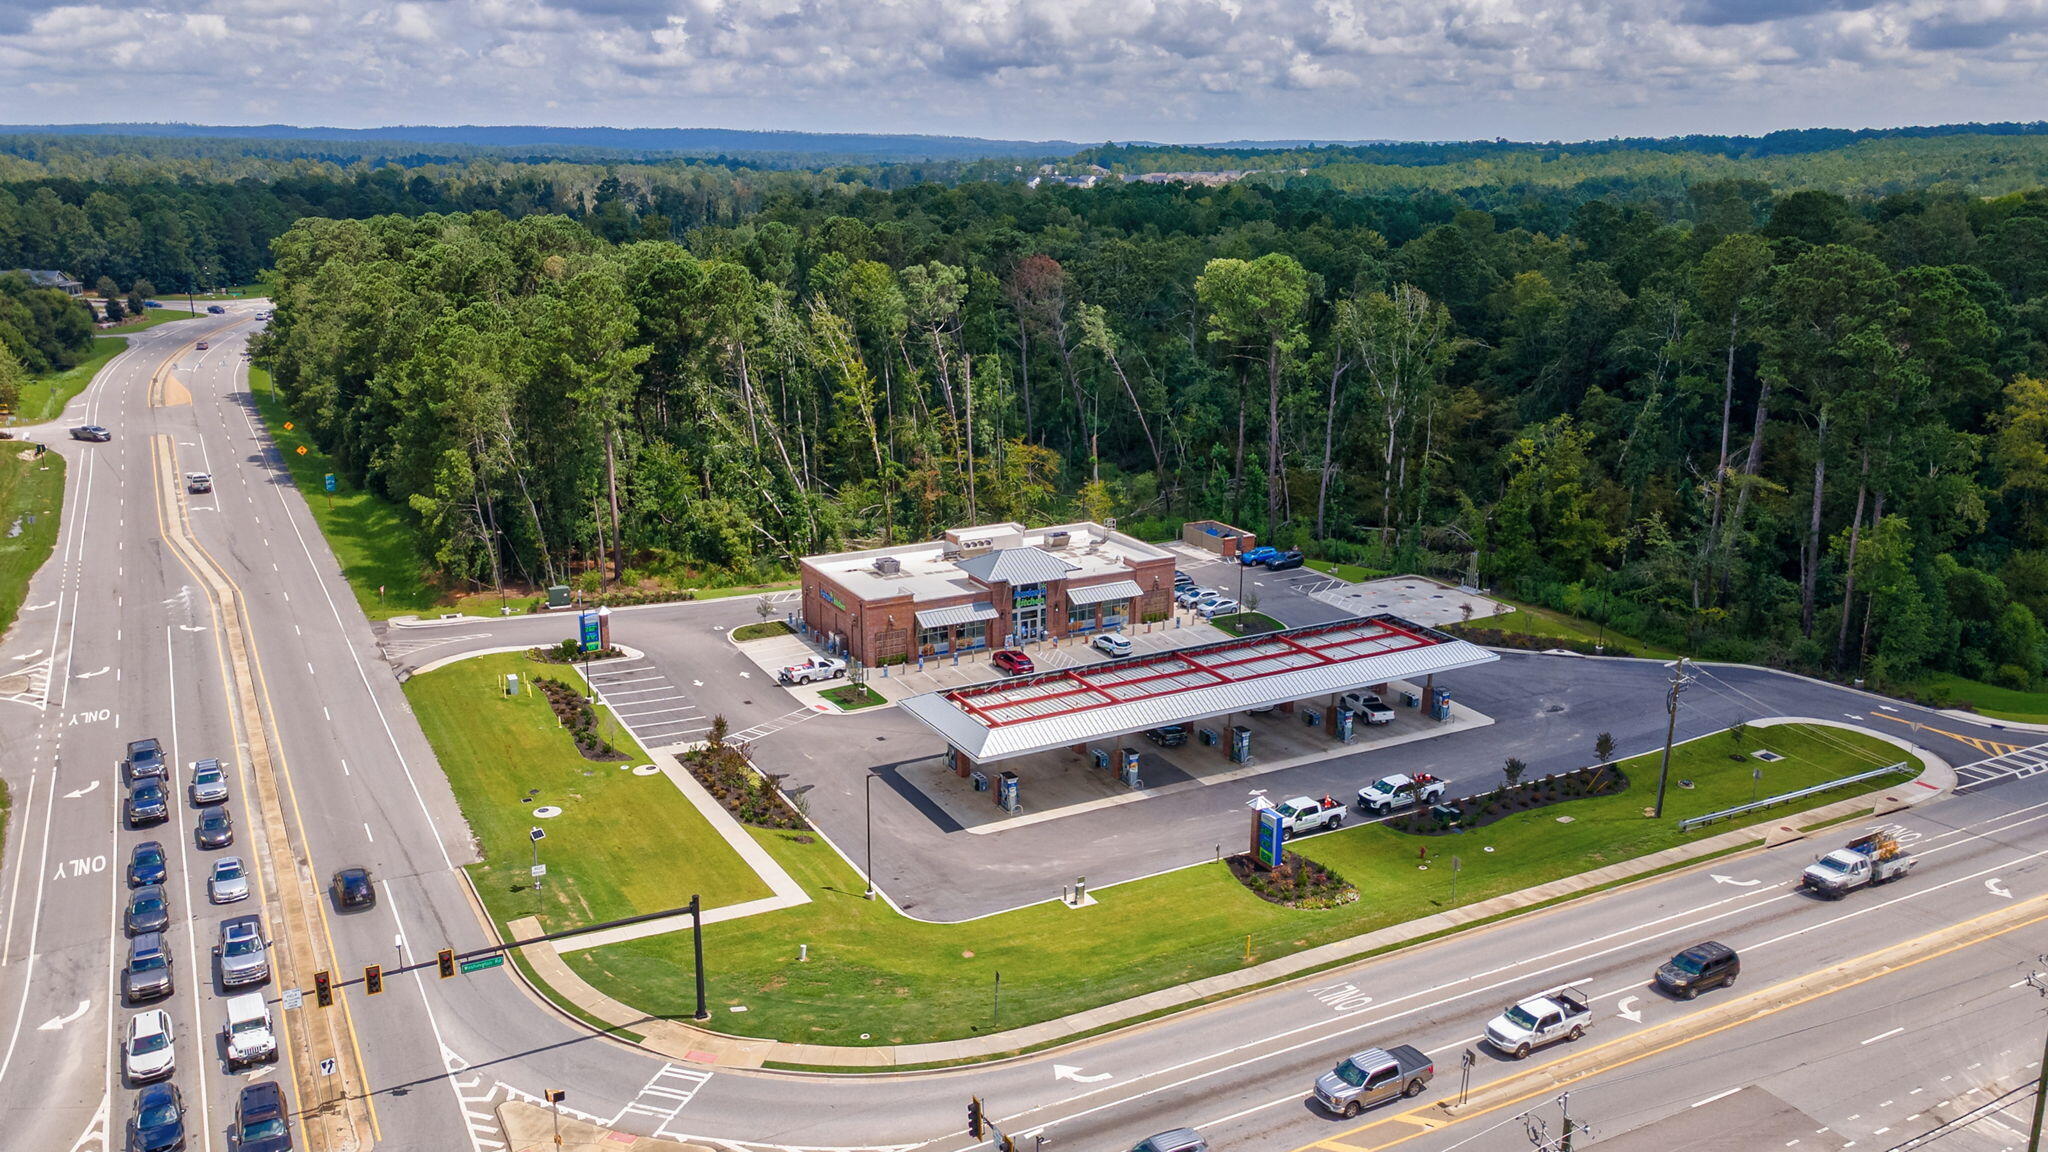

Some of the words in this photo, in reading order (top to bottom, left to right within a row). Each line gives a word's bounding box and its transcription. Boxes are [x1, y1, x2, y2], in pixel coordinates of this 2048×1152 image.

[68, 708, 110, 726] ONLY
[53, 855, 106, 881] ONLY
[1306, 981, 1373, 1011] ONLY
